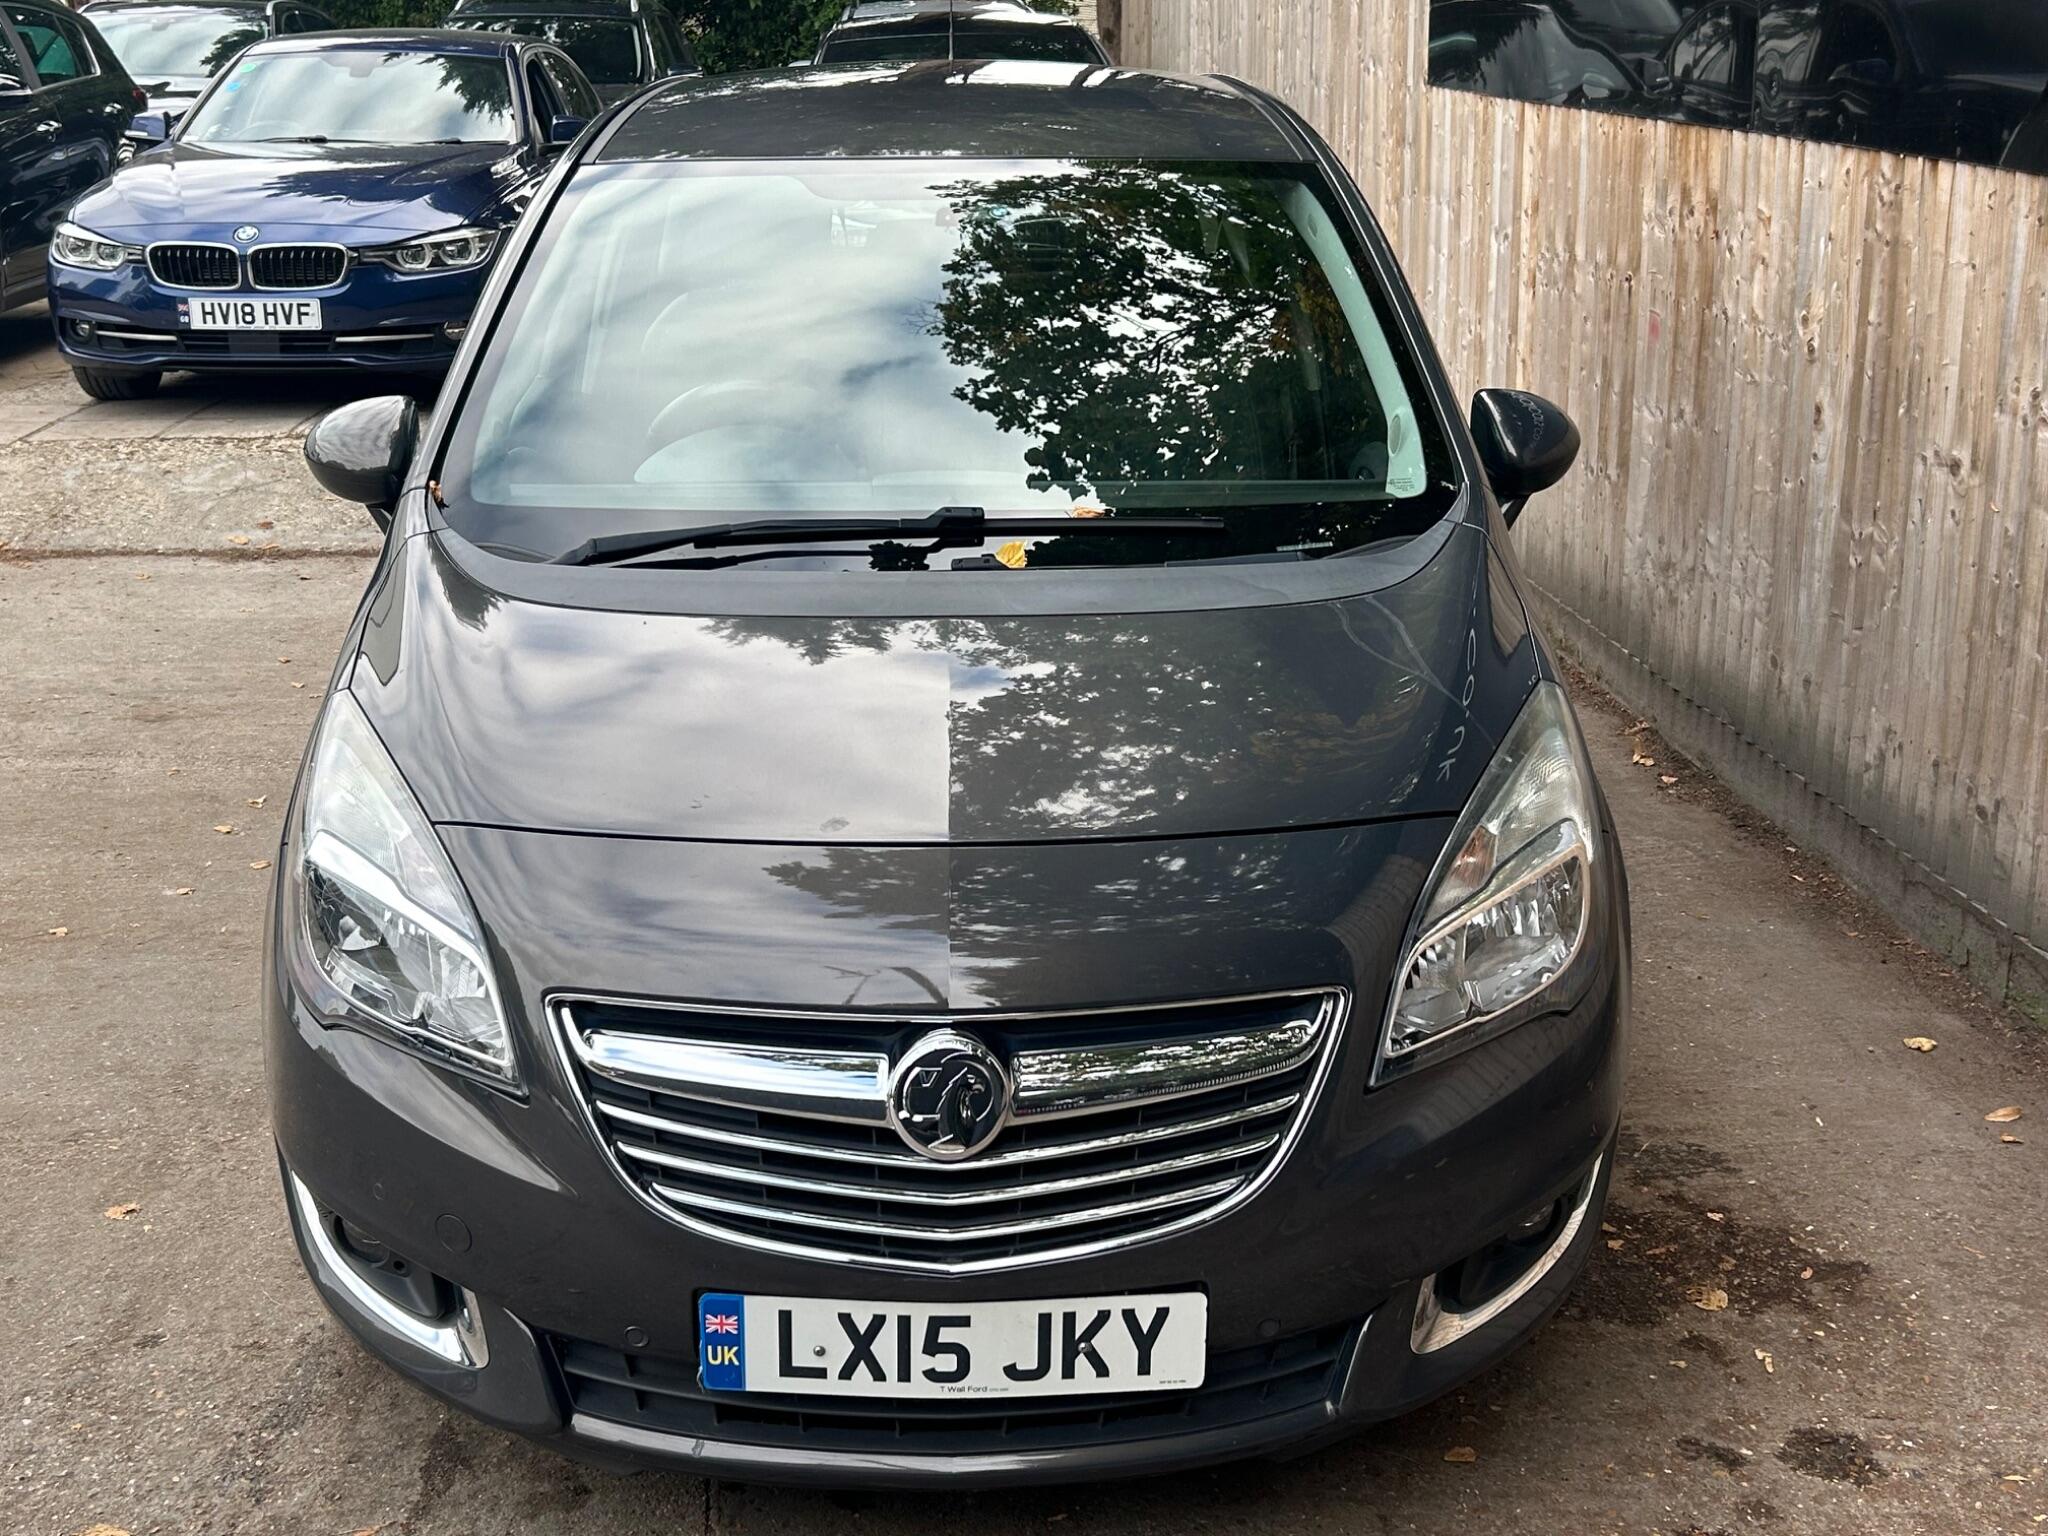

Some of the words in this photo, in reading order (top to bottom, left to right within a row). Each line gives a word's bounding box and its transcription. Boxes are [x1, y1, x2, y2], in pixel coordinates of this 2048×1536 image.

[201, 302, 256, 325] HV18
[262, 303, 311, 325] HVF
[707, 1344, 740, 1367] UK
[778, 1309, 972, 1384] LX15
[1002, 1306, 1170, 1382] JKY
